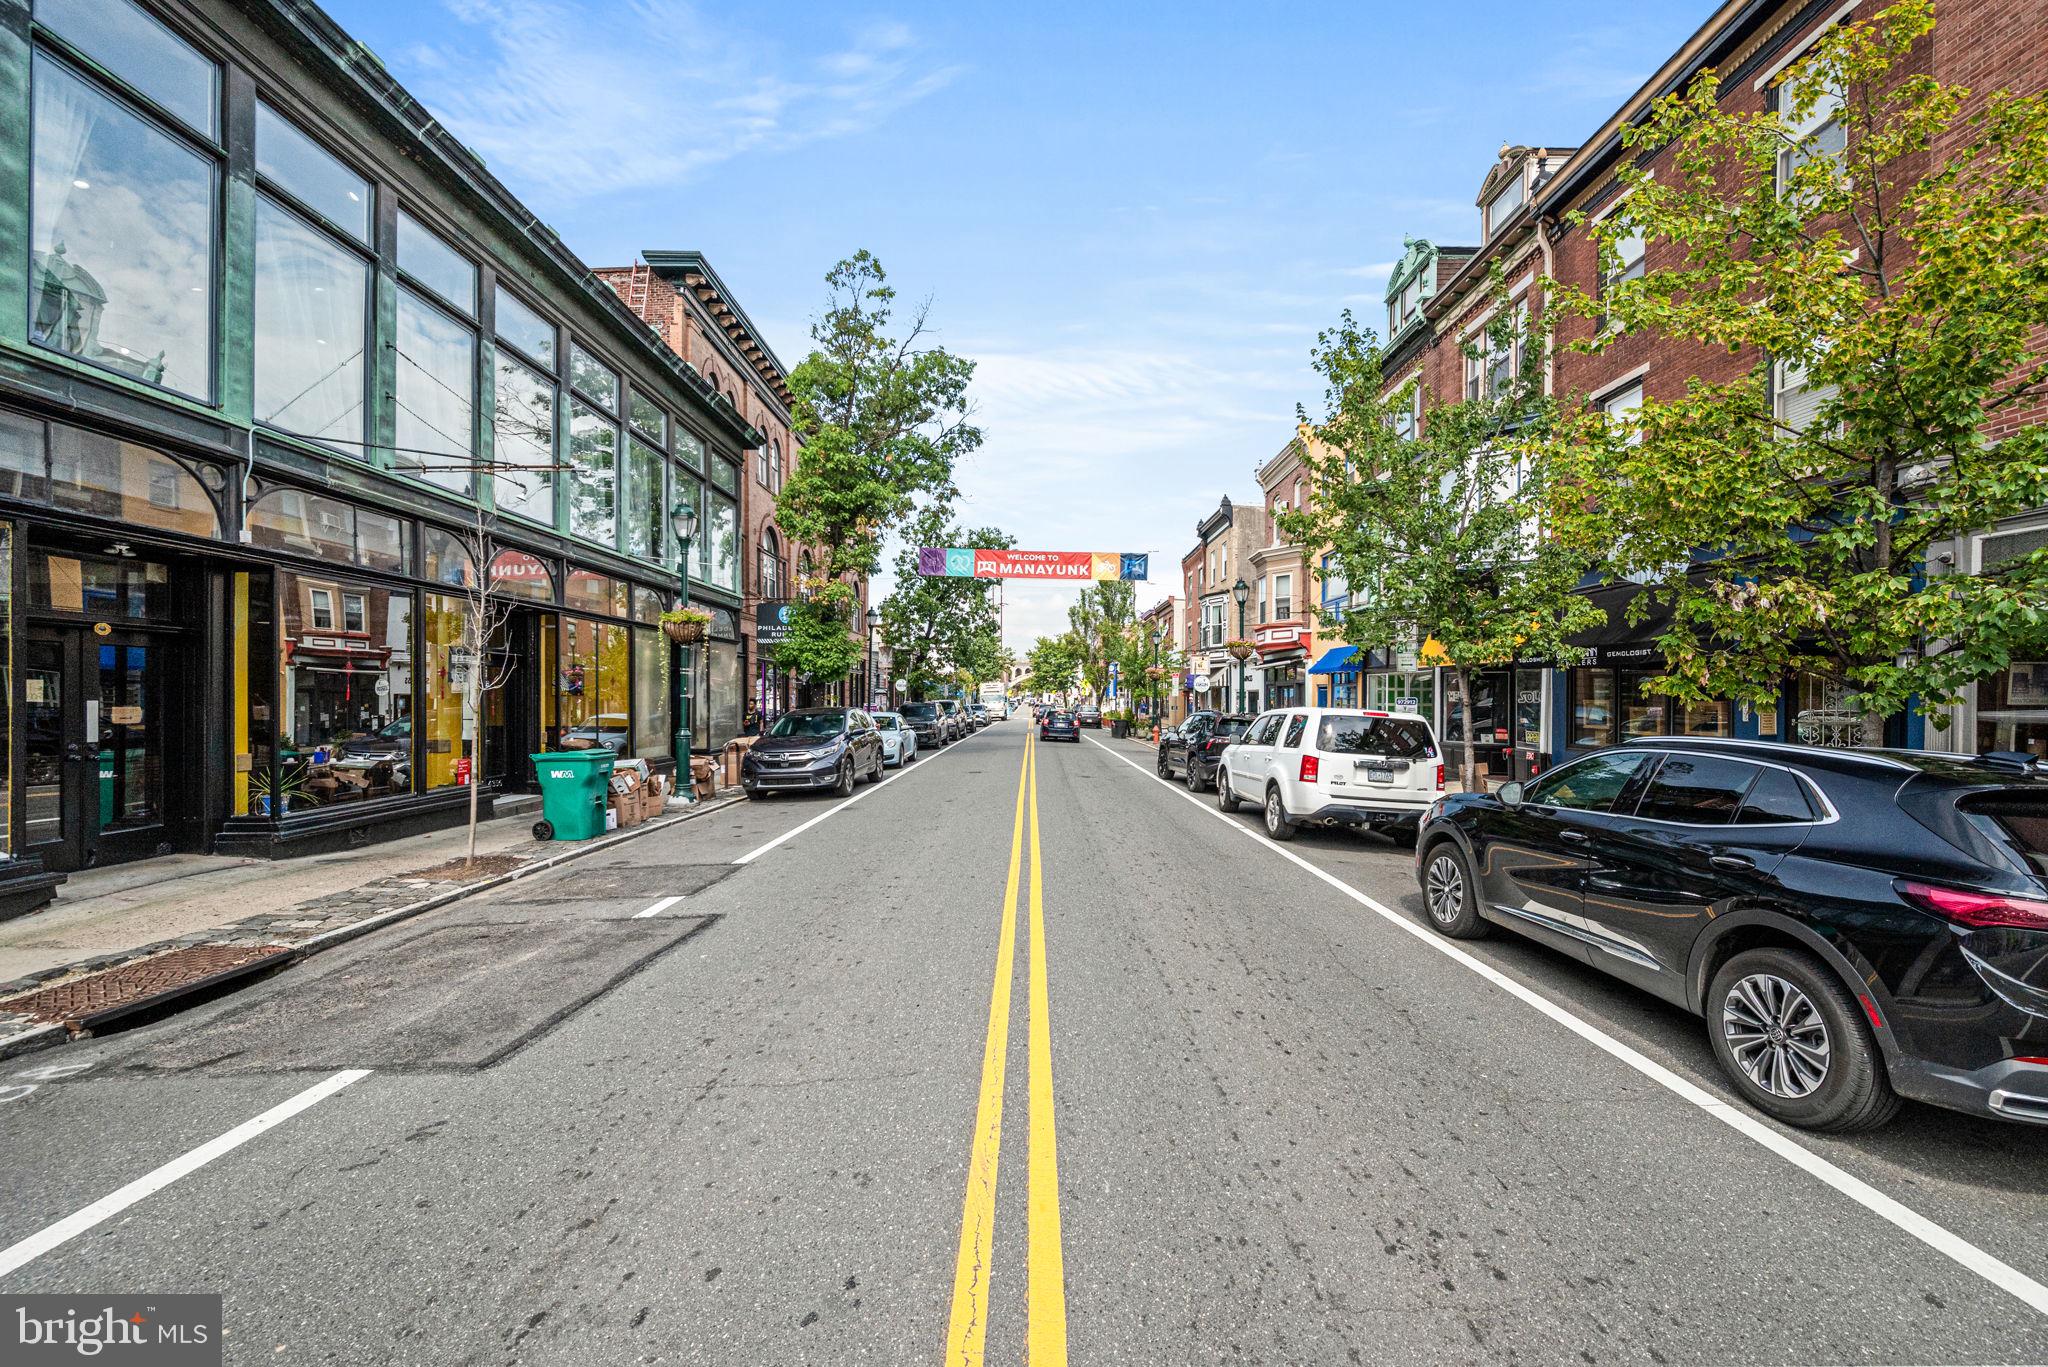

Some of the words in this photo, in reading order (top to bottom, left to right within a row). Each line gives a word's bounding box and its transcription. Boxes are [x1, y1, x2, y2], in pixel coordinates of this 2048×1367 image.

[1007, 554, 1046, 562] WELCOME
[999, 564, 1089, 576] MANAYUNK
[1606, 648, 1652, 657] GEMOLOGIST
[551, 770, 574, 778] WM
